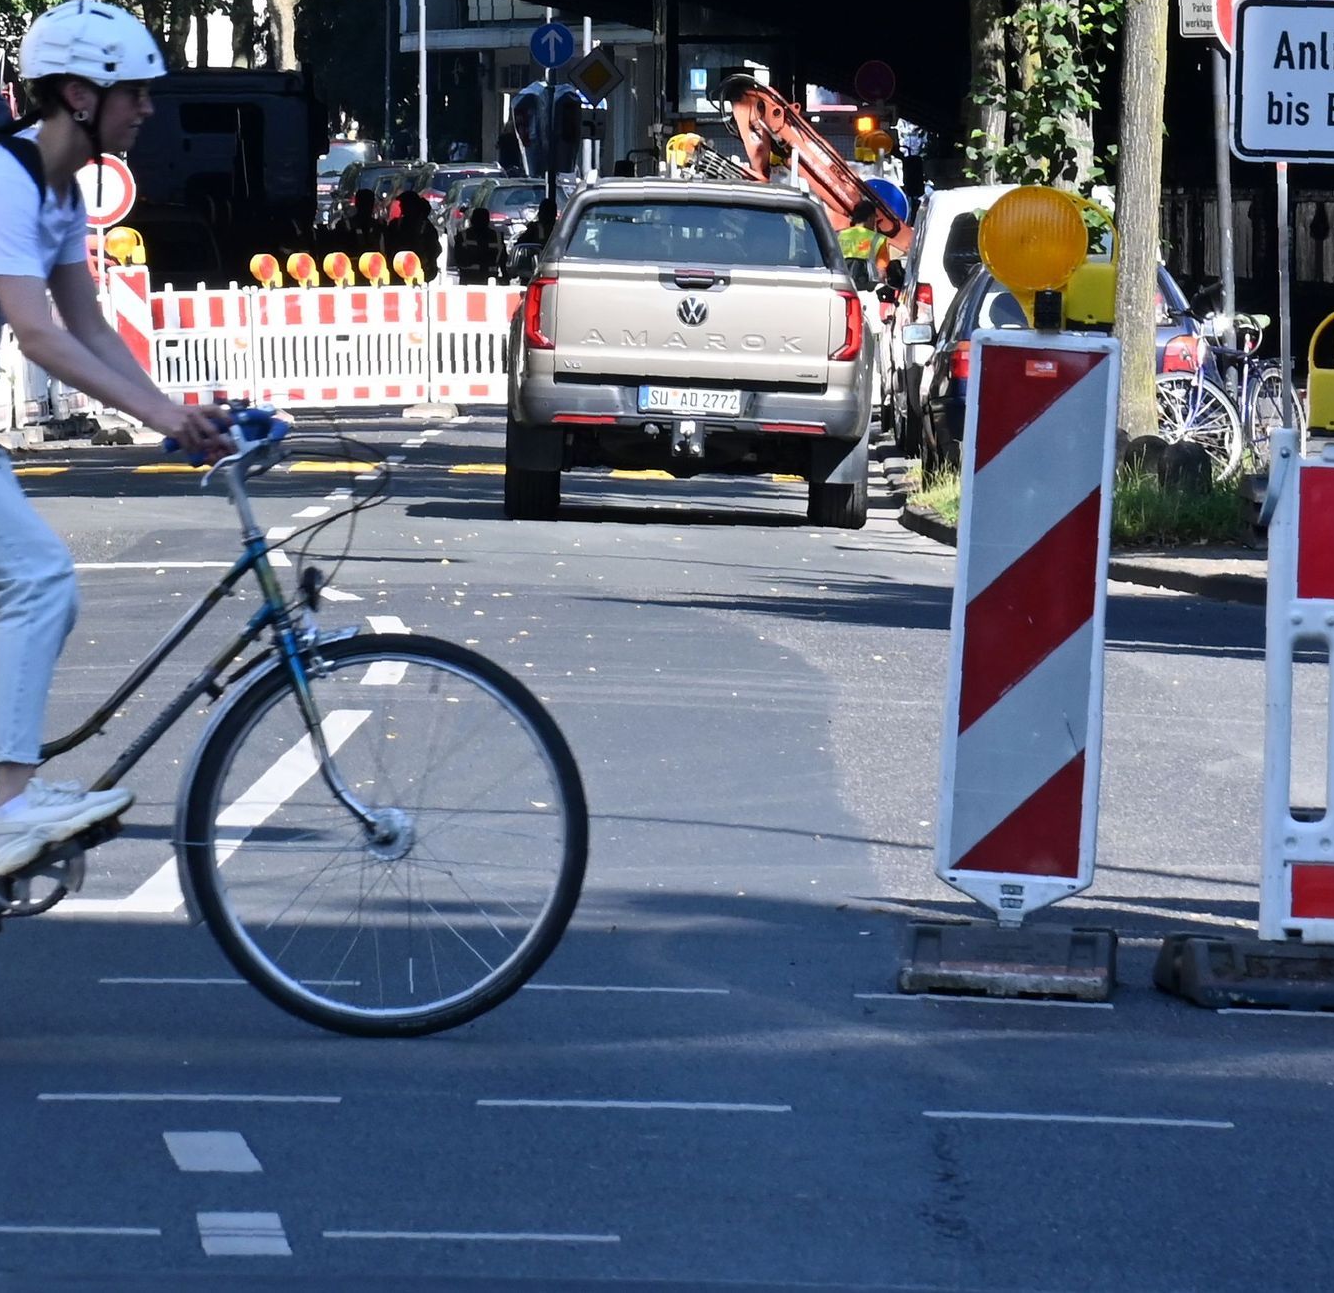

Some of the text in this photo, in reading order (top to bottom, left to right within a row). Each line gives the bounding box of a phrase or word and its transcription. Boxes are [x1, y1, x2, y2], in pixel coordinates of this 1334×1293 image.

[1267, 91, 1309, 126] bis
[580, 328, 803, 354] AMAROK
[650, 390, 668, 406] SU
[702, 394, 738, 410] 2772
